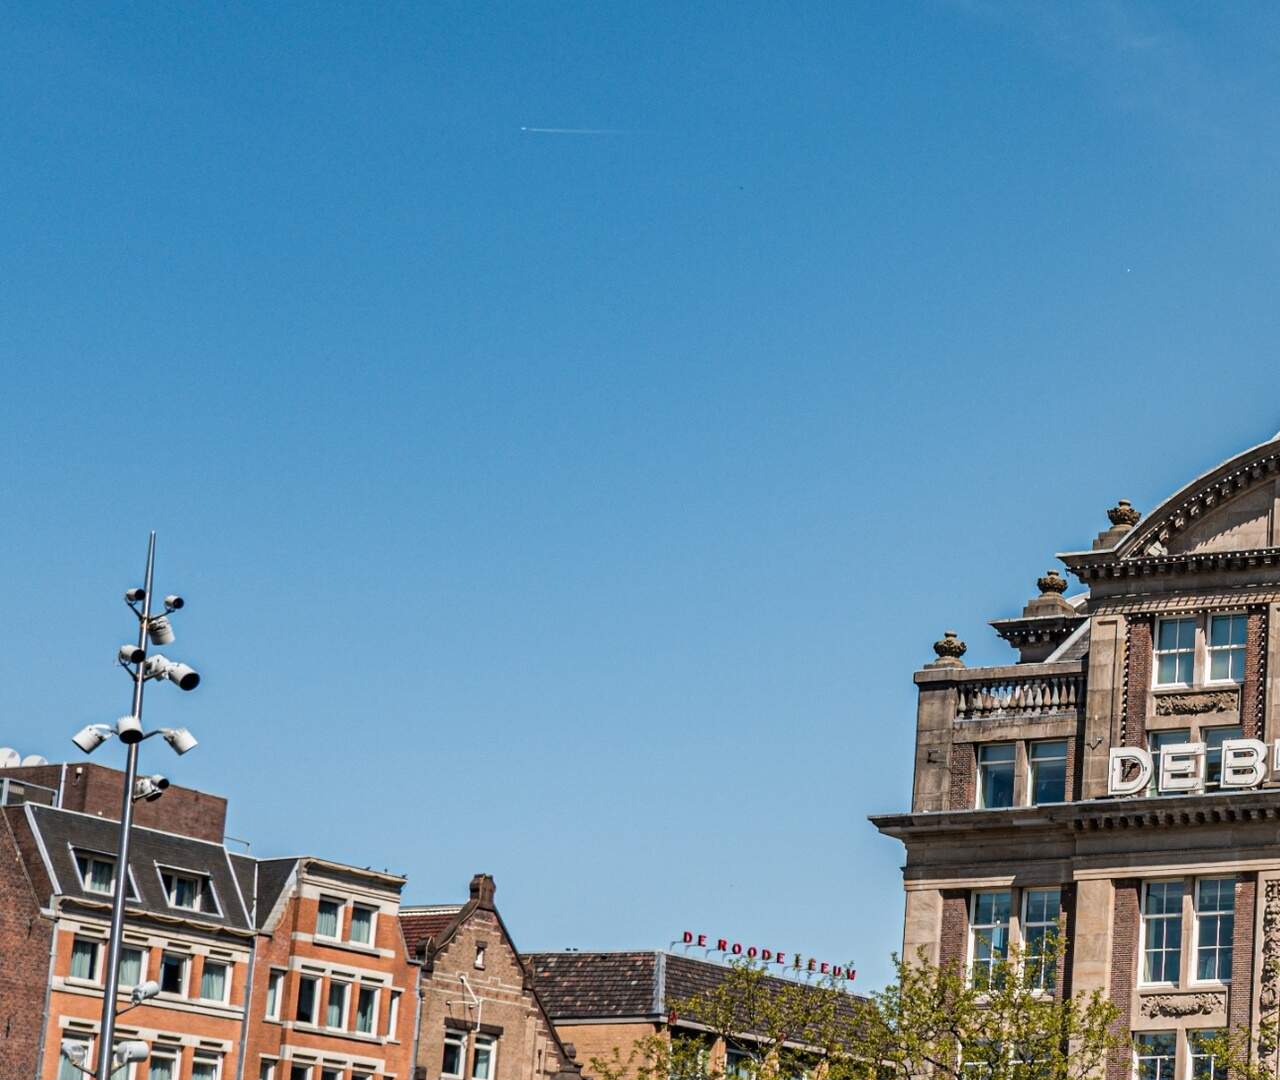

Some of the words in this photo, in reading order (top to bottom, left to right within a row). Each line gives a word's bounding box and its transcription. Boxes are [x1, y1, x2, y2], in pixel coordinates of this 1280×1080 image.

[1108, 742, 1206, 796] DE
[683, 931, 707, 948] DE
[717, 939, 786, 964] ROODE
